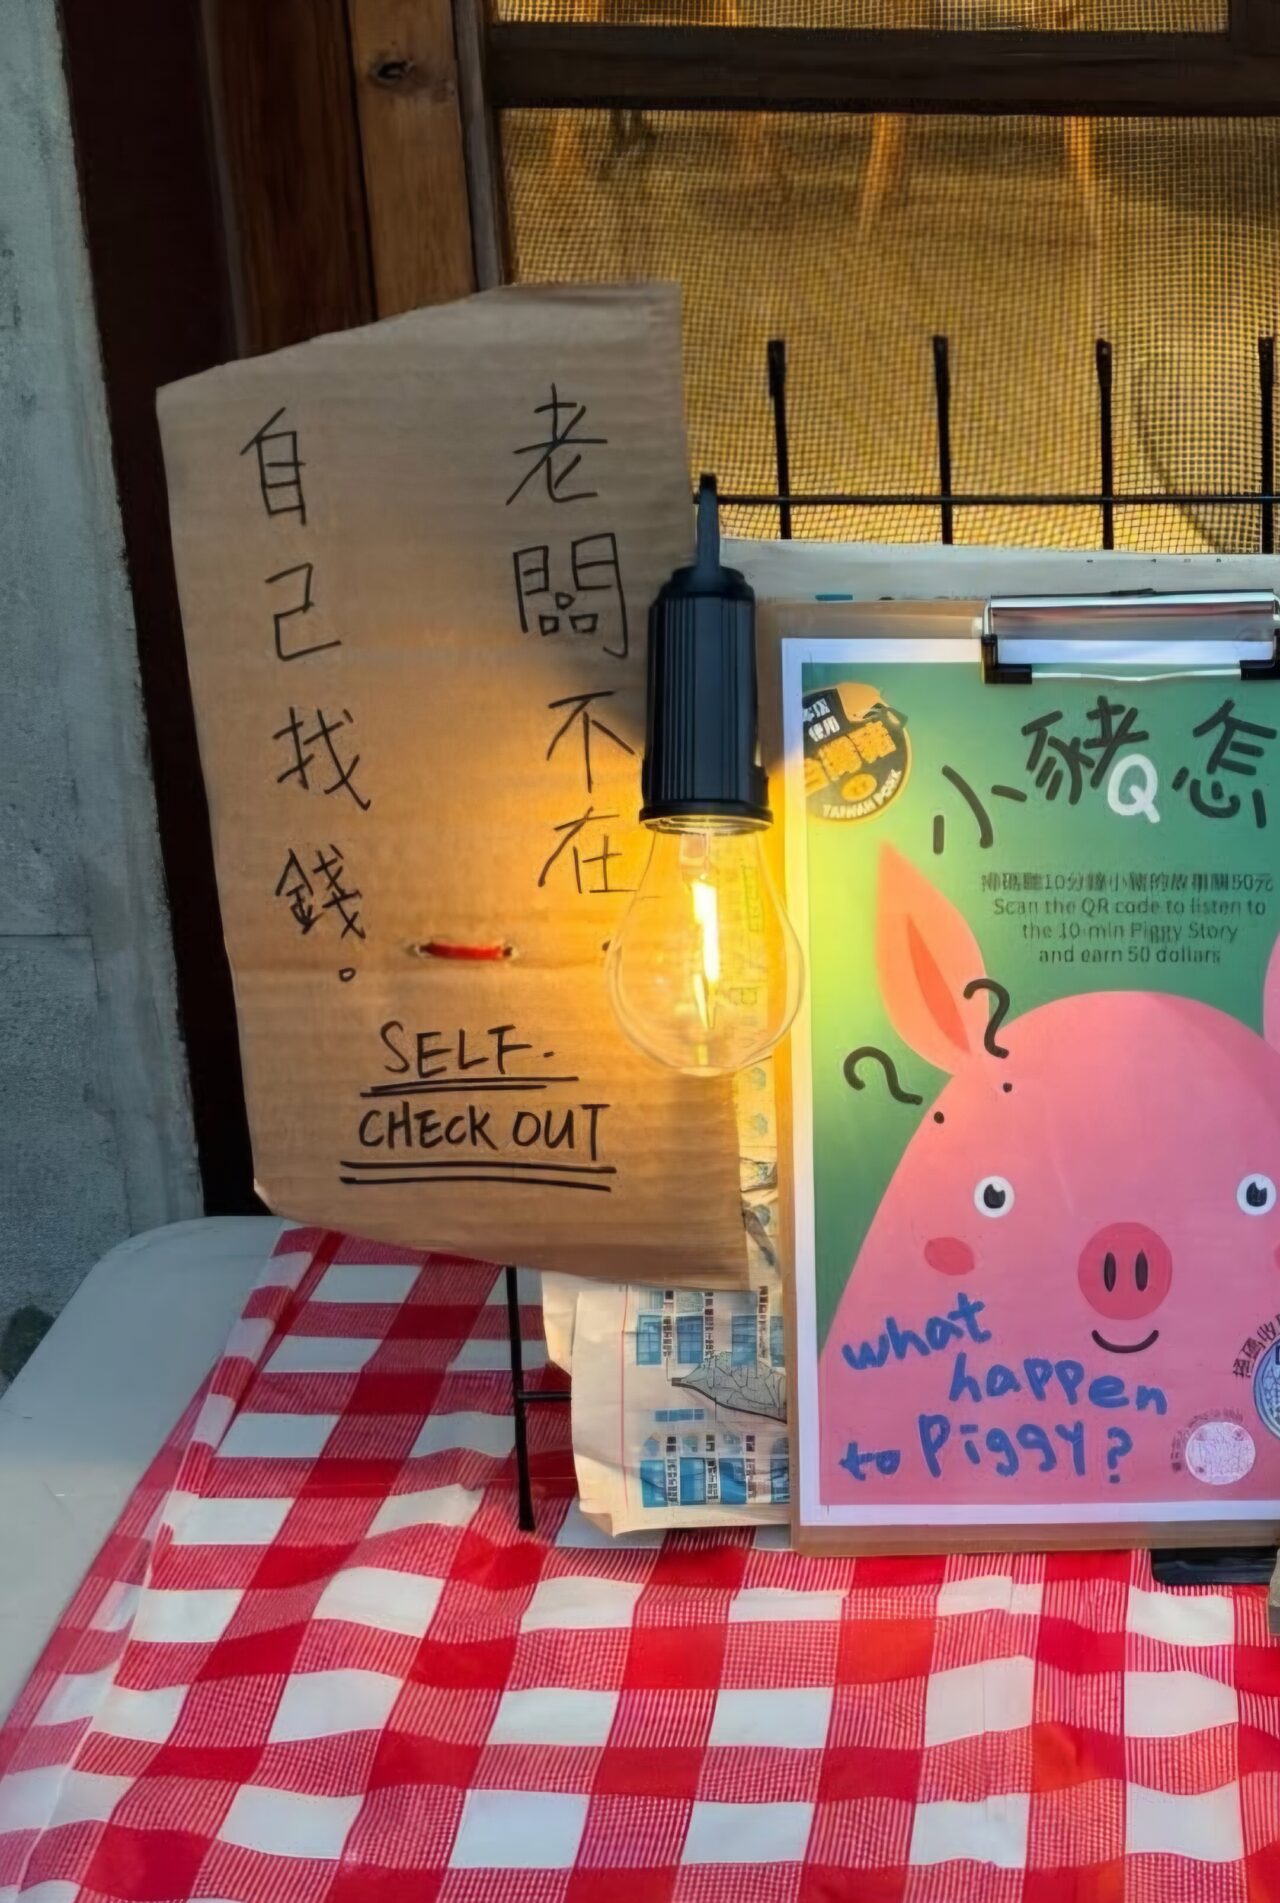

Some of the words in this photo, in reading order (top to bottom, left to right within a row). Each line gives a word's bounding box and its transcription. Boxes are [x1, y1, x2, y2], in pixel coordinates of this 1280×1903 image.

[993, 897, 1039, 915] Scan
[1045, 897, 1075, 914] the
[1081, 898, 1110, 915] QR
[1115, 898, 1160, 914] code
[1166, 899, 1185, 914] to
[1189, 898, 1242, 915] listen
[1248, 899, 1266, 915] to
[1022, 922, 1053, 938] the
[1130, 922, 1183, 943] Piggy
[1188, 922, 1239, 943] Story
[1038, 946, 1074, 963] and
[1081, 949, 1123, 963] earn
[1127, 946, 1150, 963] 50
[1156, 946, 1221, 963] dollars
[358, 1100, 498, 1149] CHECK
[512, 1102, 611, 1160] OUT
[842, 1292, 992, 1371] what
[839, 1441, 901, 1482] to
